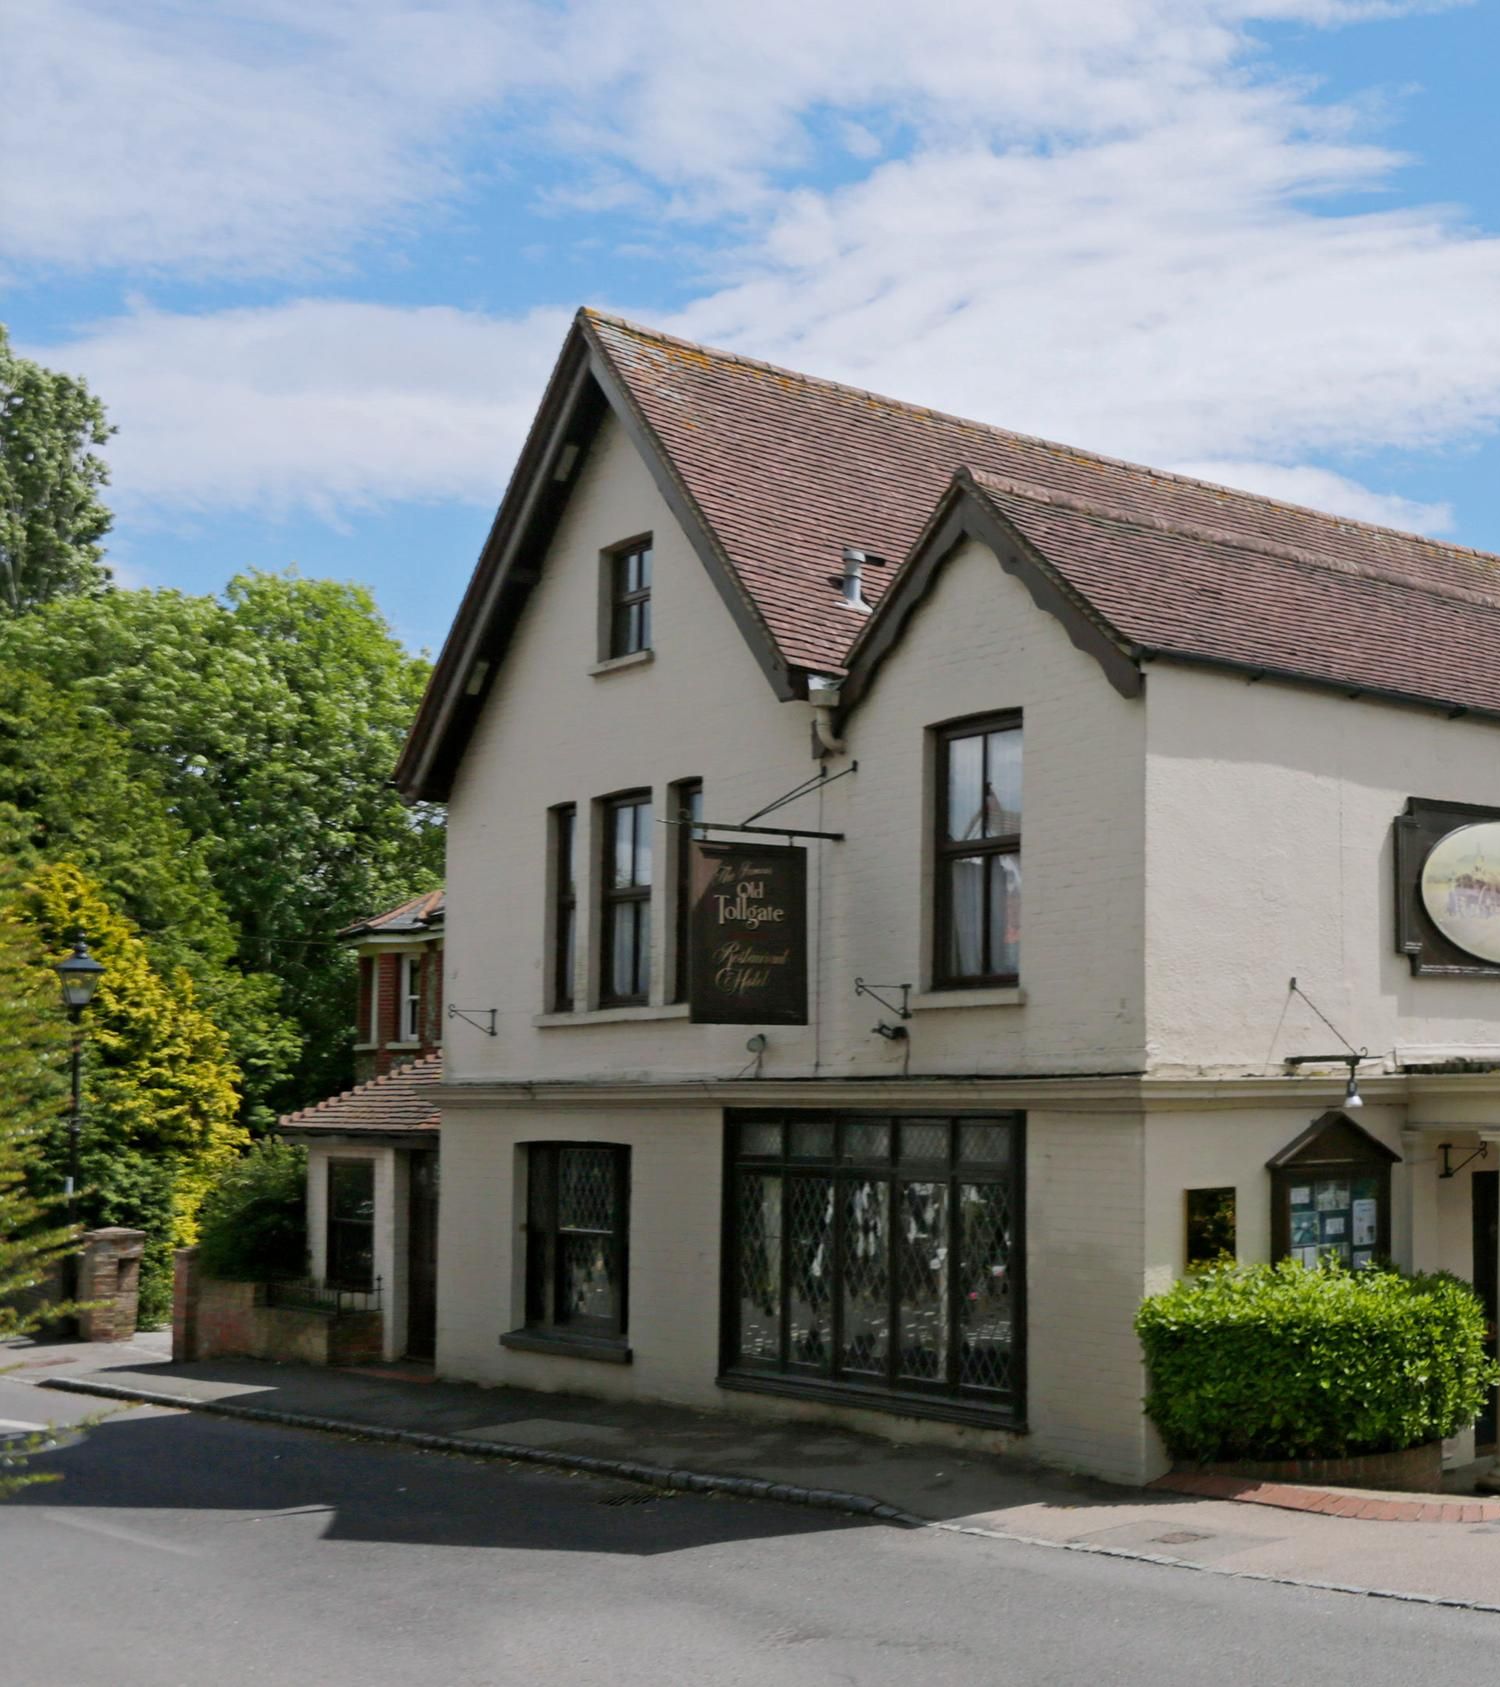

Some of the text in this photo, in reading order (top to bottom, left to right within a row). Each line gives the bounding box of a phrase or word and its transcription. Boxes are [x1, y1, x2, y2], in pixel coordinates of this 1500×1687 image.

[736, 881, 764, 899] Old
[713, 893, 785, 930] Tollgate
[713, 941, 791, 967] Restaurant
[733, 968, 770, 995] Hotel
